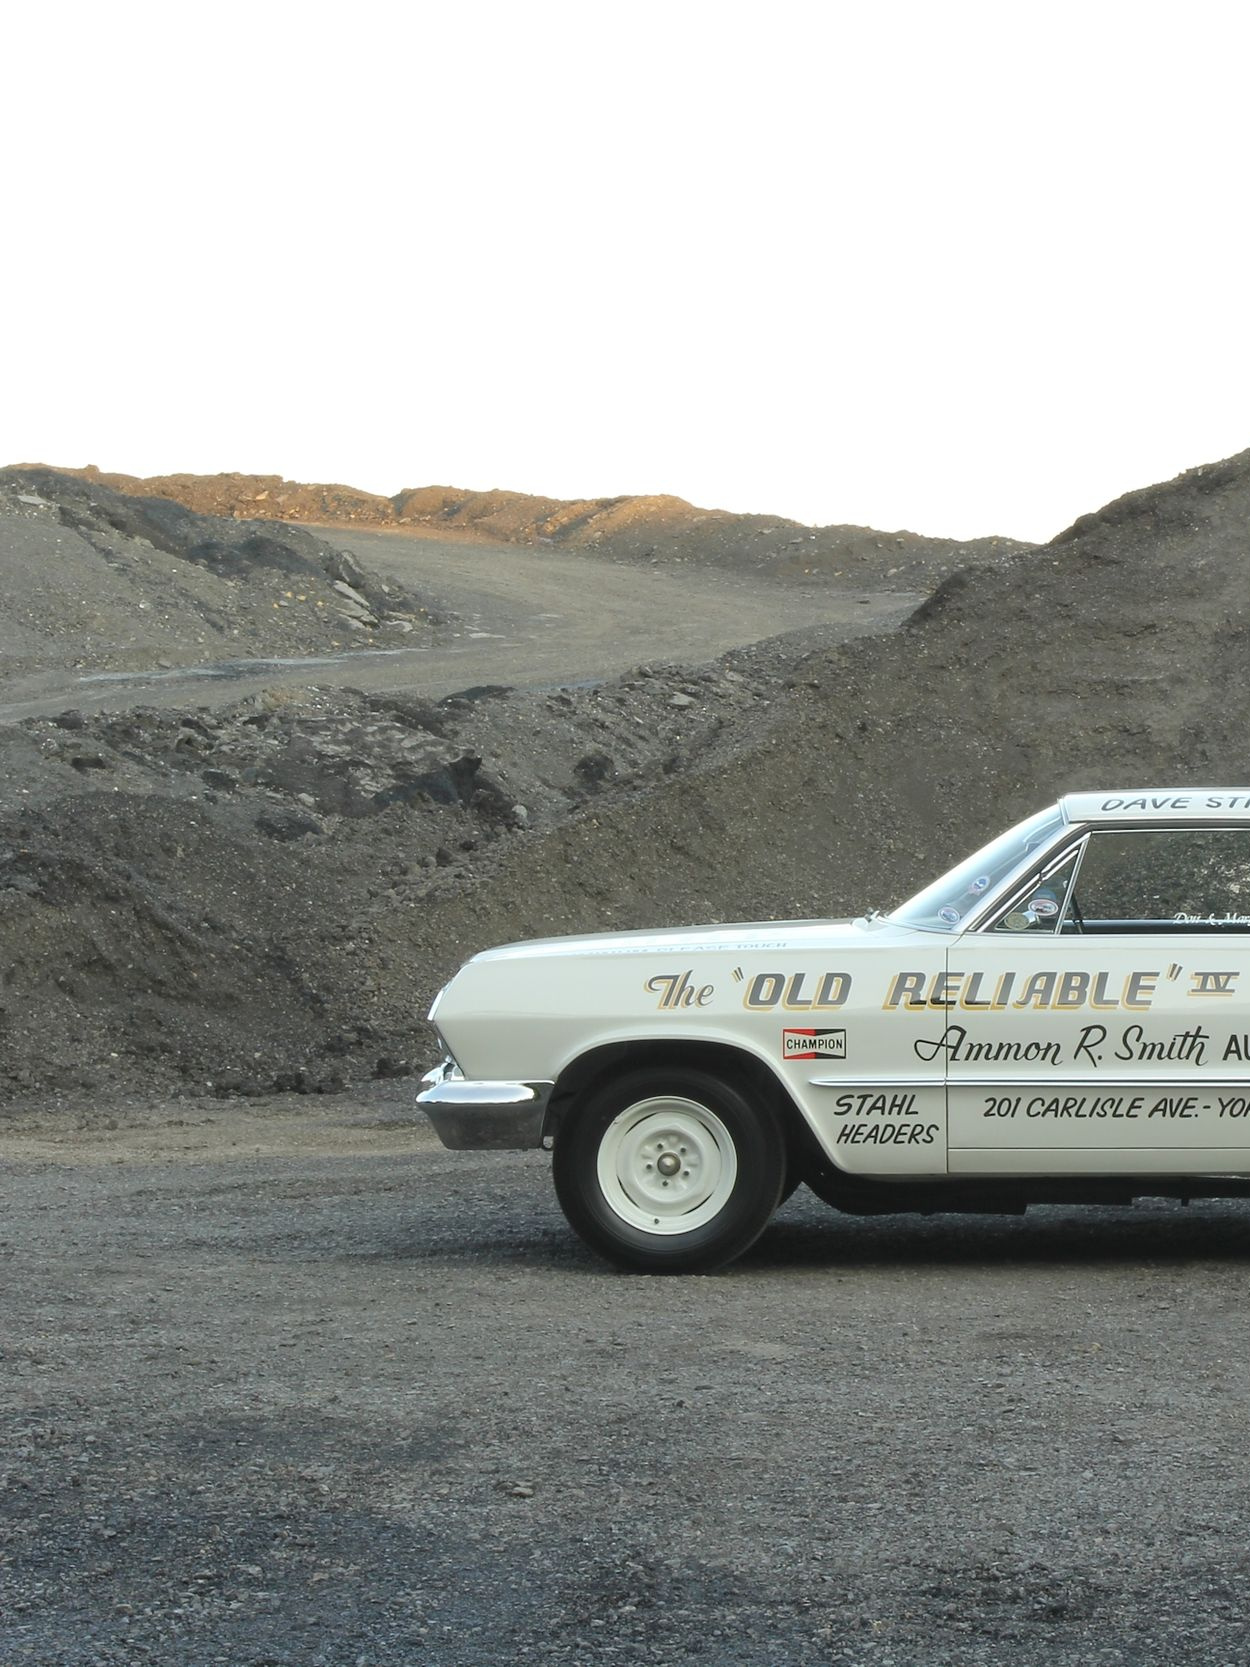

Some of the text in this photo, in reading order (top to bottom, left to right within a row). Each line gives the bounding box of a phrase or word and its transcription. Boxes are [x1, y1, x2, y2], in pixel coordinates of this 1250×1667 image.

[1101, 797, 1192, 811] DAVE
[643, 969, 715, 1010] The
[1187, 971, 1240, 997] IV
[786, 1038, 843, 1050] CHAMPION
[913, 1024, 1063, 1066] Ammon
[1073, 1024, 1107, 1067] R.
[1114, 1024, 1210, 1067] Smith
[833, 1093, 919, 1116] STAHL
[983, 1097, 1022, 1118] 201
[1025, 1097, 1145, 1118] CARLISLE
[836, 1123, 940, 1146] HEADERS
